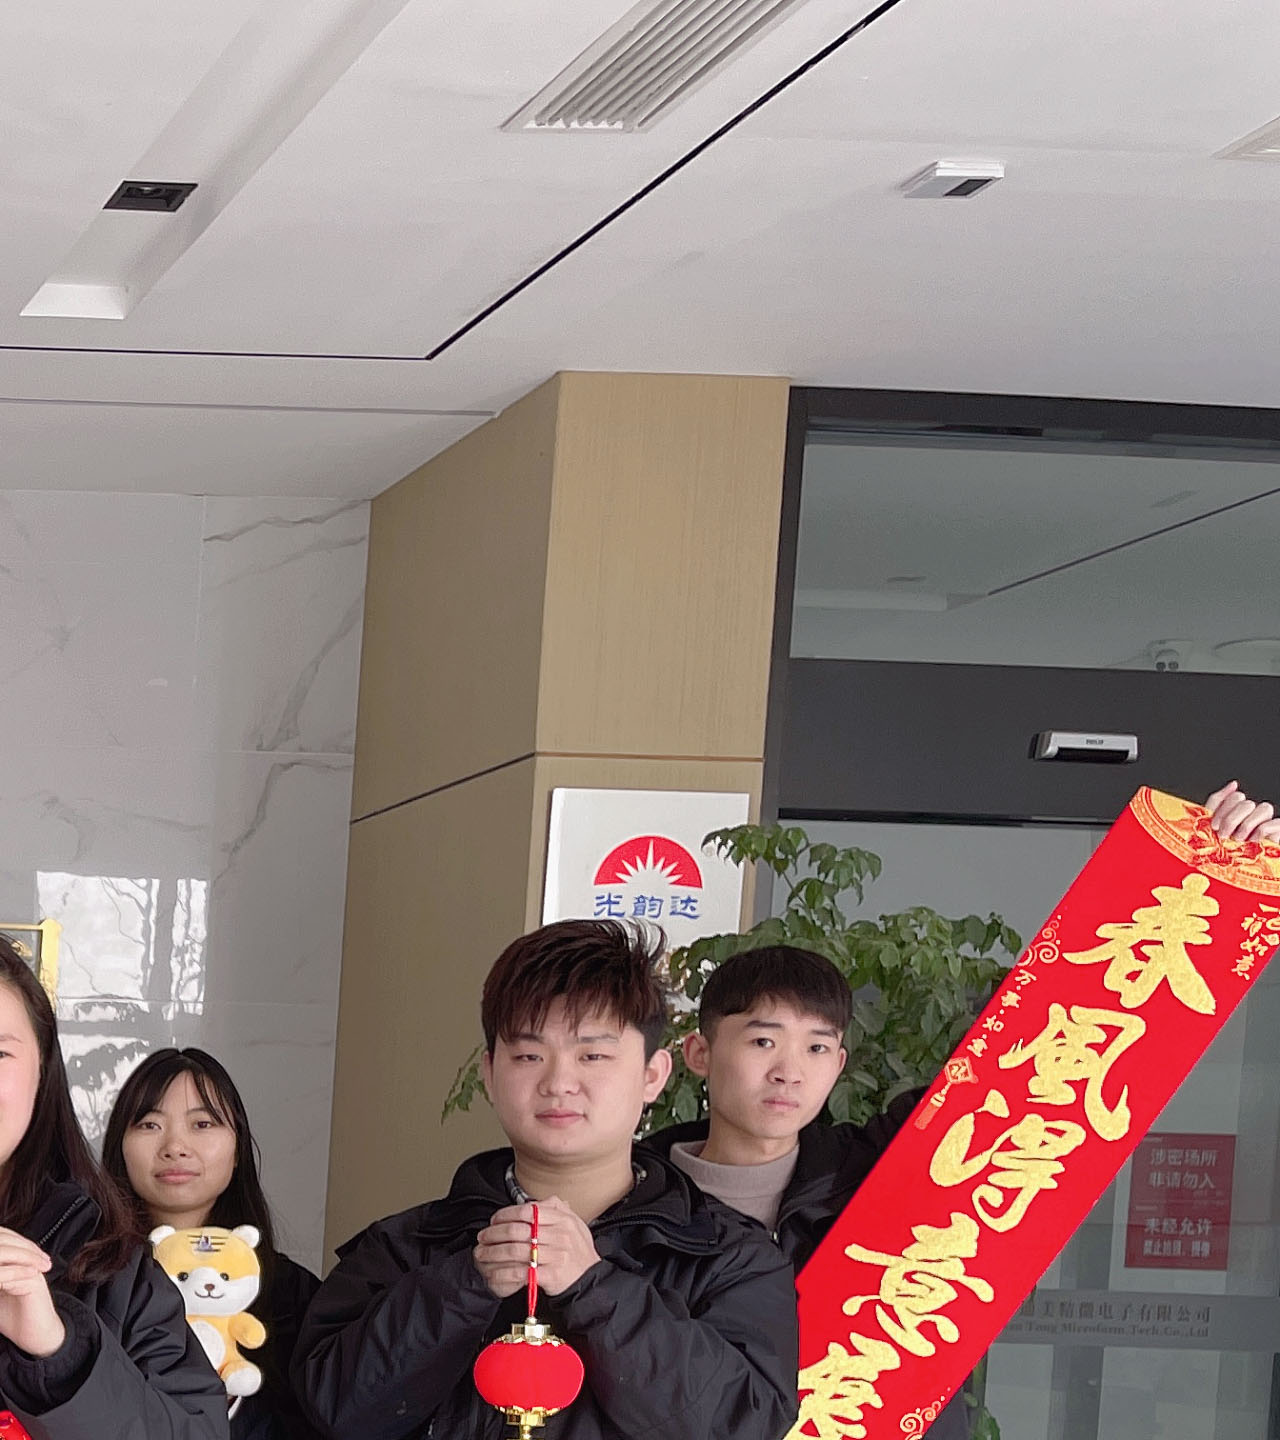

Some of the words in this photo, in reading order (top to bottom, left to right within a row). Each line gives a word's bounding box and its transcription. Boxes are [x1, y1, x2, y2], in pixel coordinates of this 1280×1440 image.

[593, 892, 703, 920] 光韵达
[1147, 1171, 1215, 1189] 非请勿入
